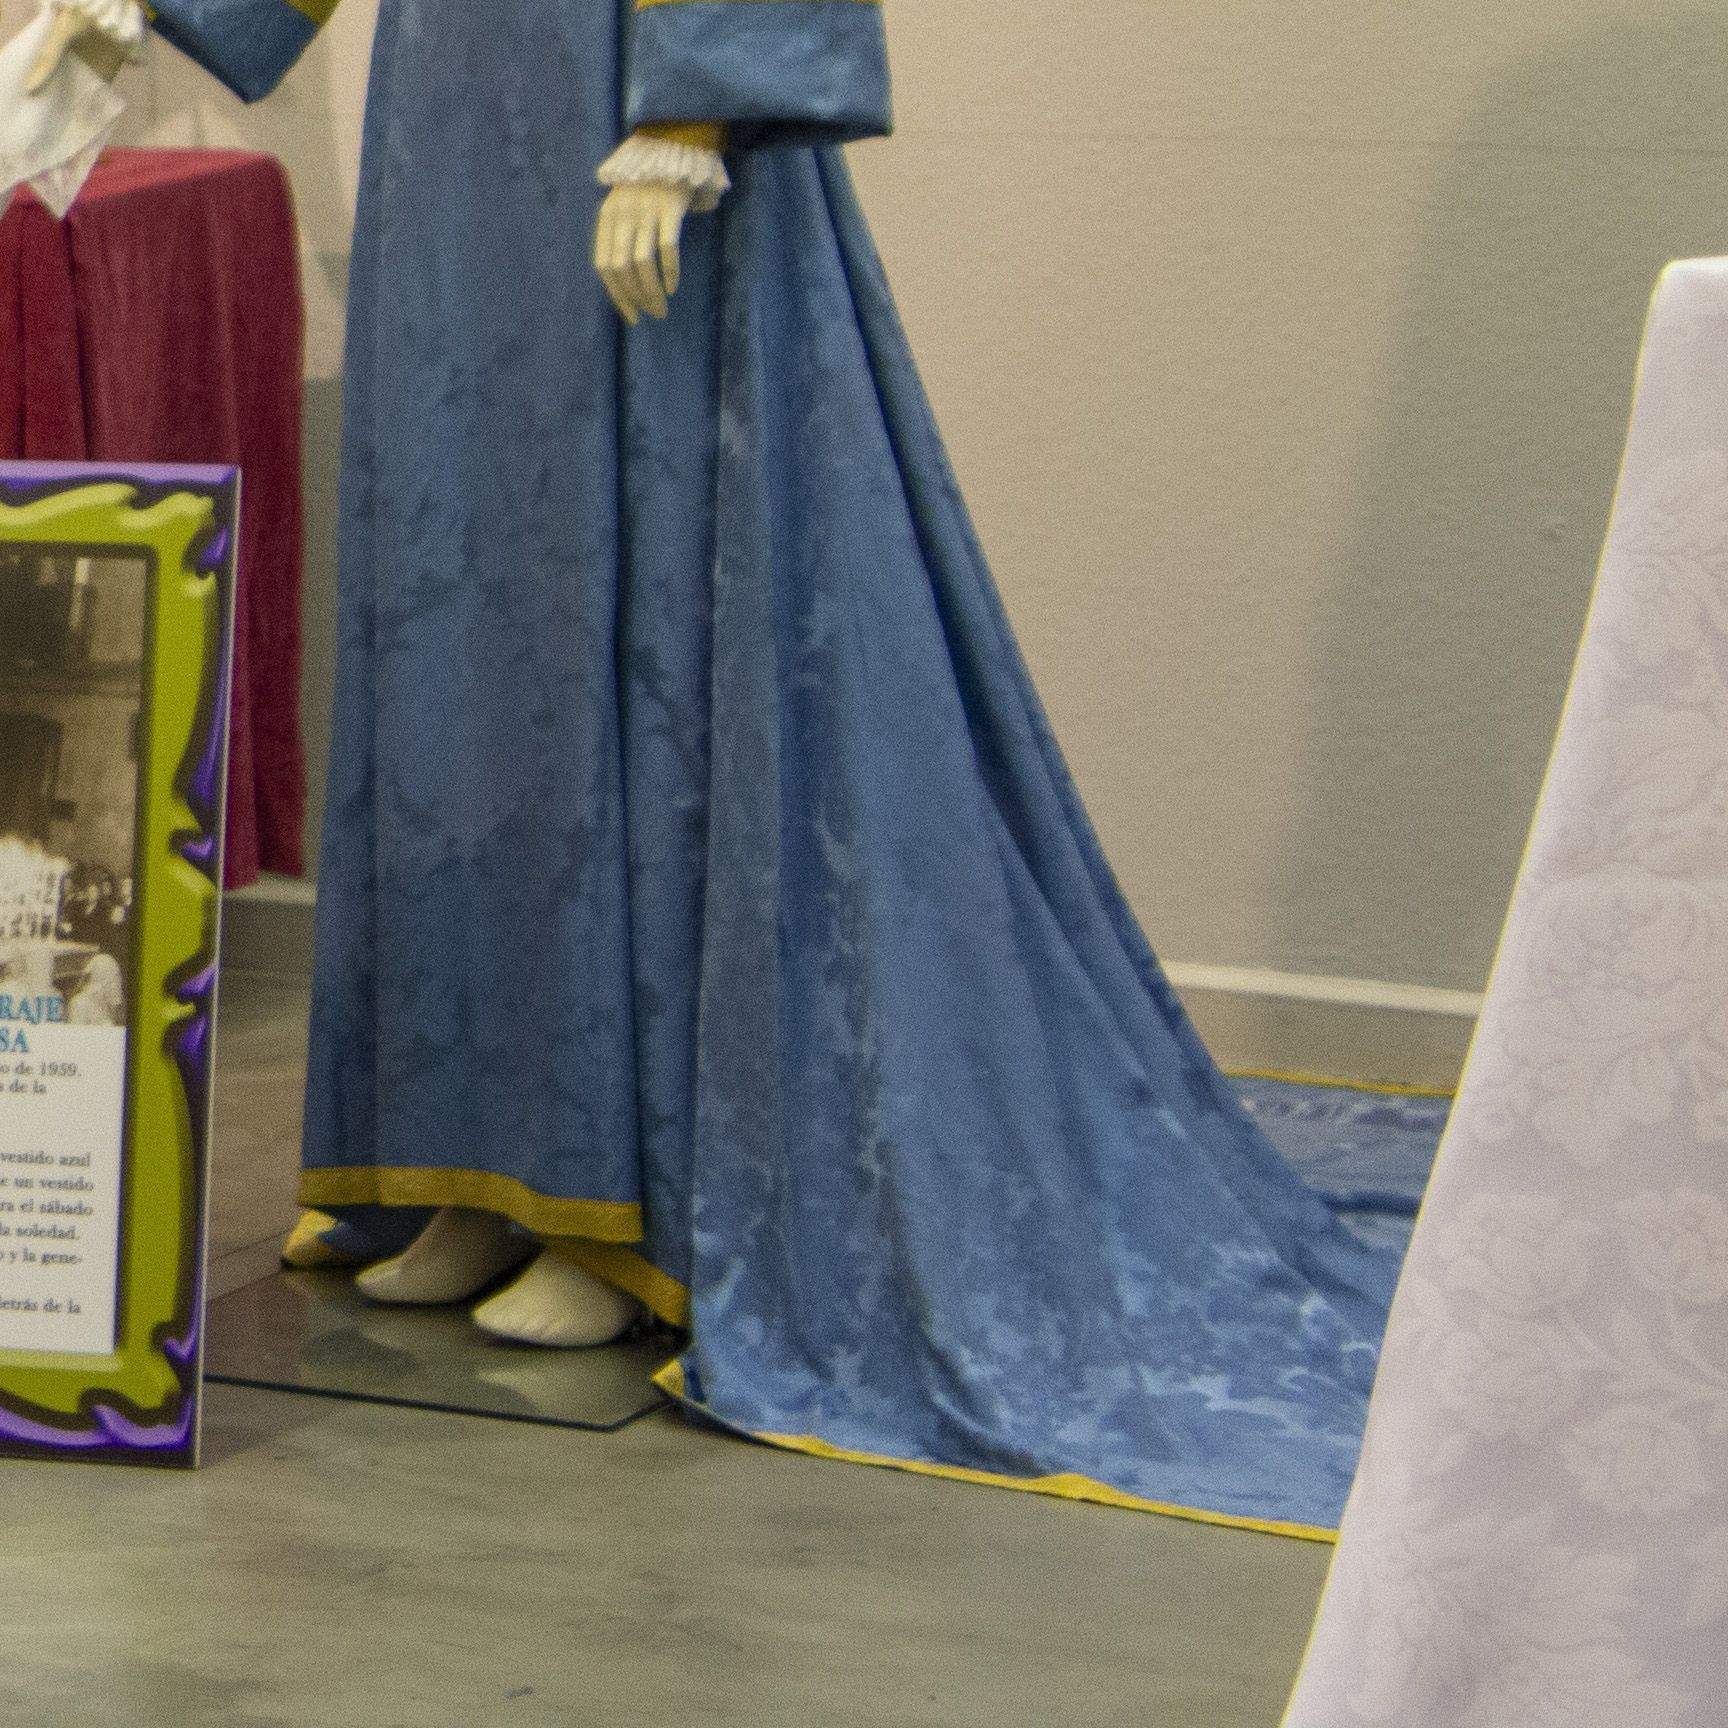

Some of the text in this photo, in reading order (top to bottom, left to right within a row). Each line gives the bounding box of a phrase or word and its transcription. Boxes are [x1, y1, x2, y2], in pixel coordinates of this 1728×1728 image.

[15, 1061, 33, 1075] de
[9, 1079, 28, 1092] de
[33, 1080, 47, 1093] la
[0, 1150, 54, 1165] vestido
[58, 1152, 91, 1167] azul
[14, 1177, 33, 1188] un
[39, 1176, 94, 1191] vestido
[20, 1198, 34, 1212] el
[40, 1199, 94, 1215] sábado
[9, 1251, 18, 1263] y
[23, 1248, 36, 1262] la
[43, 1298, 62, 1312] de
[68, 1299, 81, 1313] la
